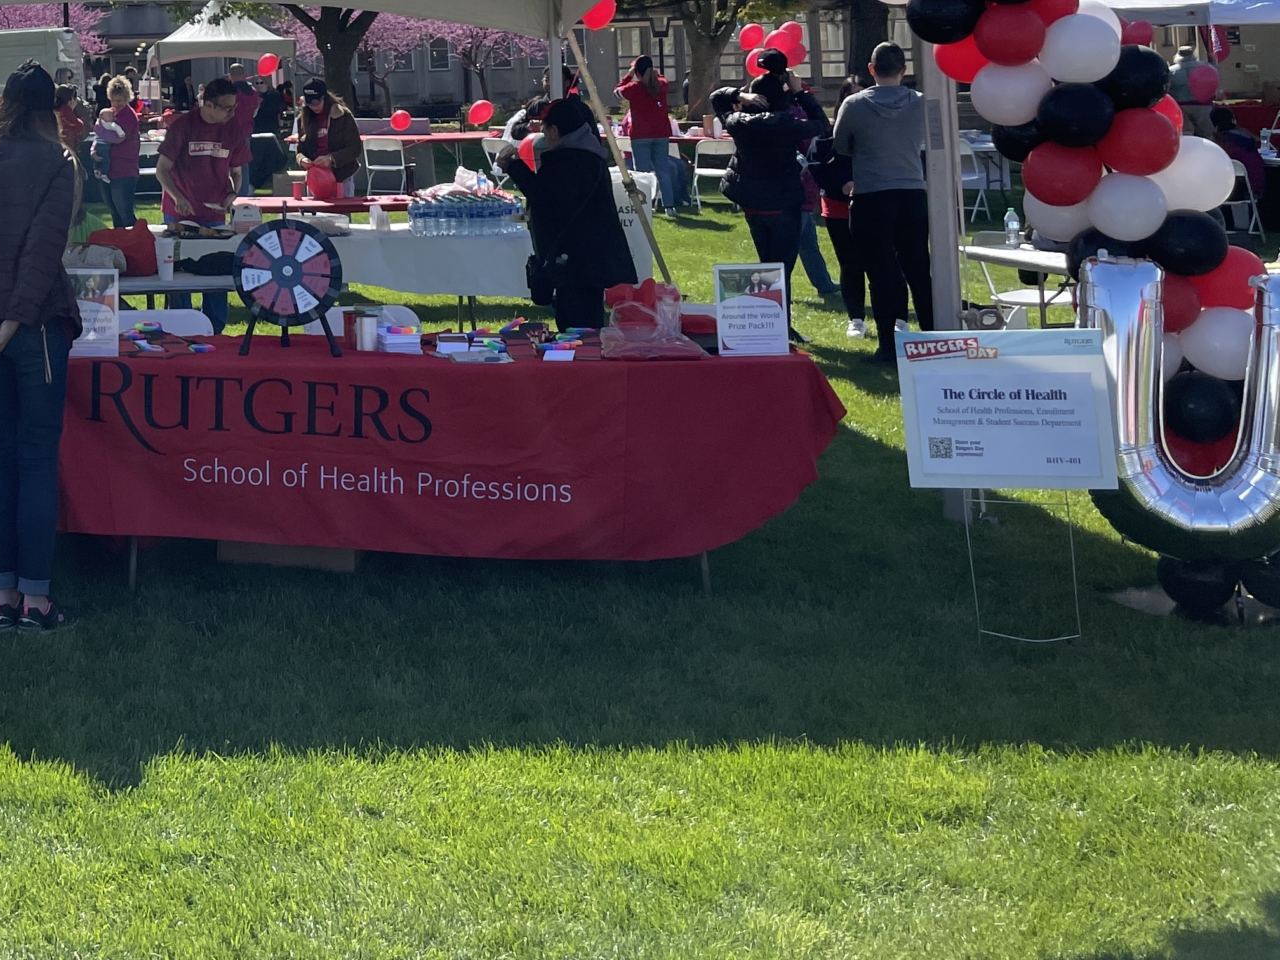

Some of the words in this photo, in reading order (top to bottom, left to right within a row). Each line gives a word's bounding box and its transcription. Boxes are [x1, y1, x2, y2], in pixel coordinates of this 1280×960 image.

[618, 206, 637, 214] ASH
[620, 219, 634, 227] LY
[903, 338, 978, 356] RUTGERS
[968, 348, 996, 358] DAY
[941, 388, 965, 400] The
[968, 388, 1005, 400] Circle
[1009, 389, 1021, 400] of
[1025, 389, 1067, 400] Health
[85, 360, 433, 455] RUTGERS
[937, 406, 960, 414] School
[961, 406, 970, 414] of
[971, 406, 993, 414] Health
[1036, 407, 1075, 415] Enrollment
[932, 417, 976, 427] Management
[986, 418, 1012, 426] Student
[1012, 418, 1040, 426] Success
[1041, 418, 1082, 428] Department
[183, 457, 270, 486] School
[282, 462, 309, 488] of
[320, 465, 404, 495] Health
[417, 472, 572, 504] Professions
